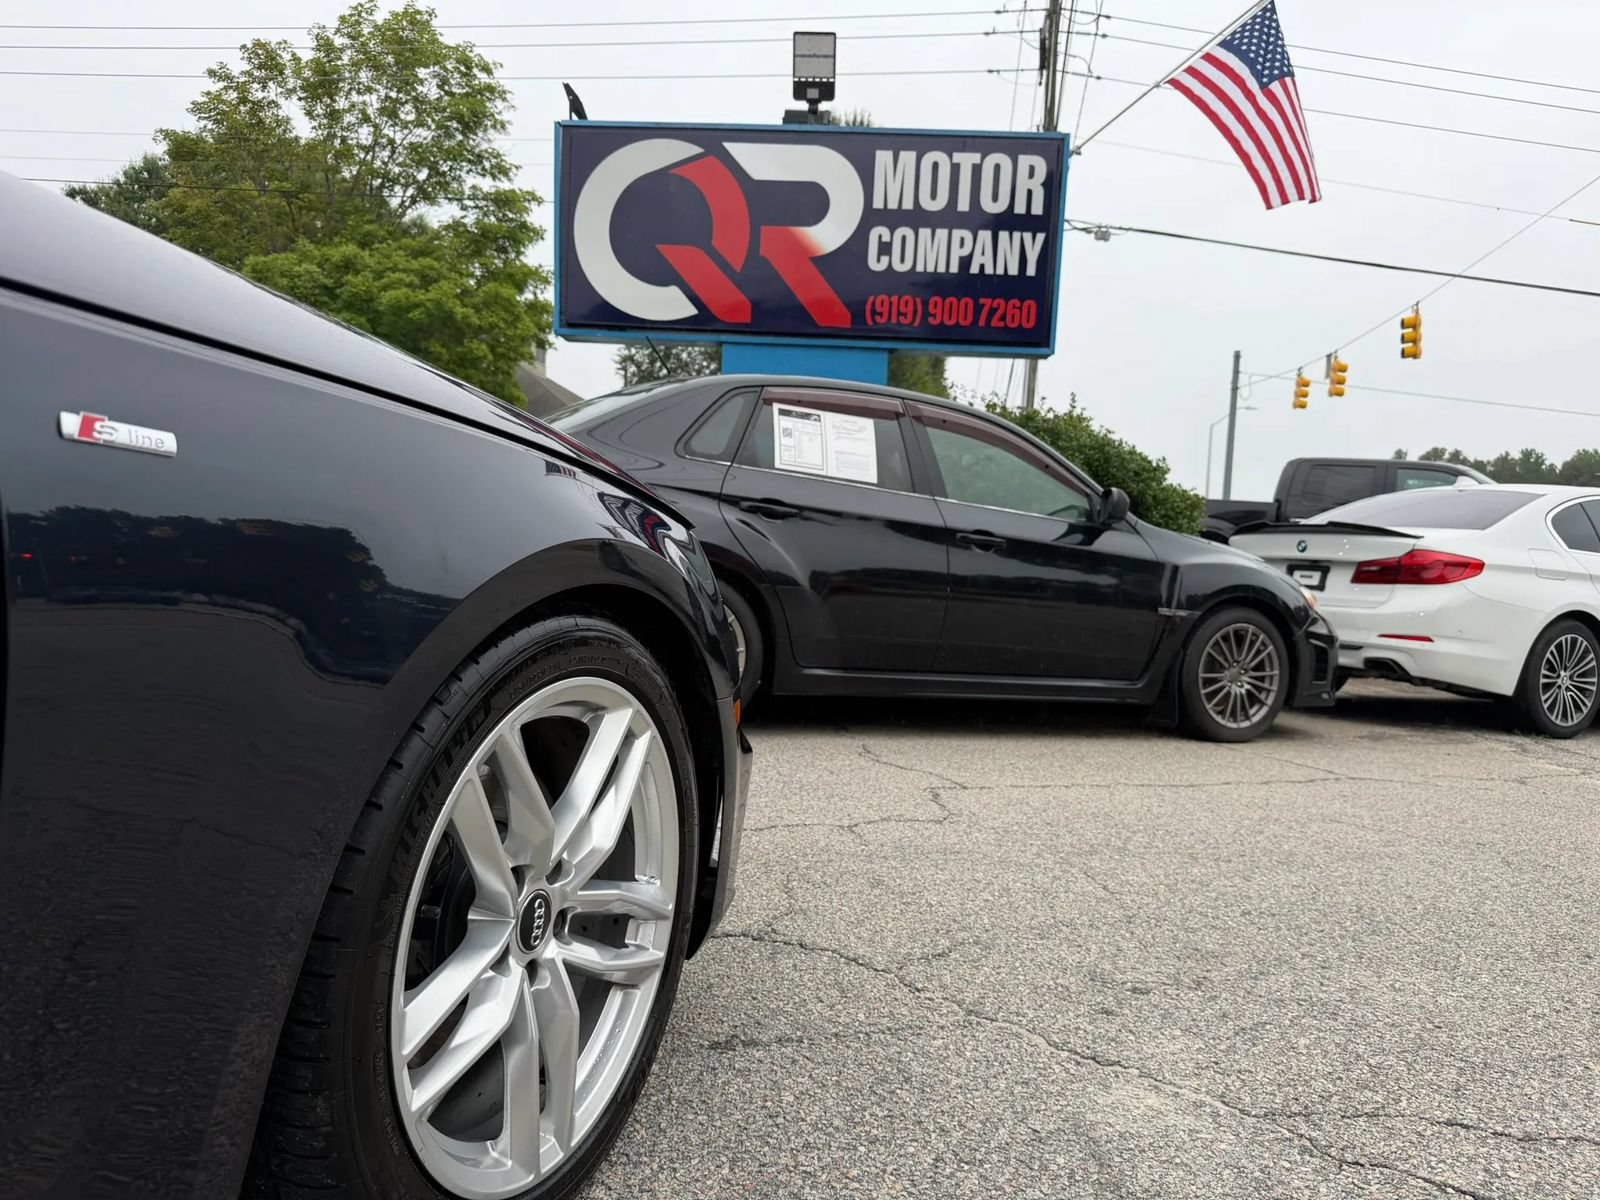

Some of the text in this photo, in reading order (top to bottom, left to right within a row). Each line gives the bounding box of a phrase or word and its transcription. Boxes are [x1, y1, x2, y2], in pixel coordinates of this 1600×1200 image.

[872, 149, 1047, 216] MOTOR
[867, 226, 1046, 277] COMPANY
[864, 294, 1037, 329] (919) 900 7260
[128, 429, 165, 450] line
